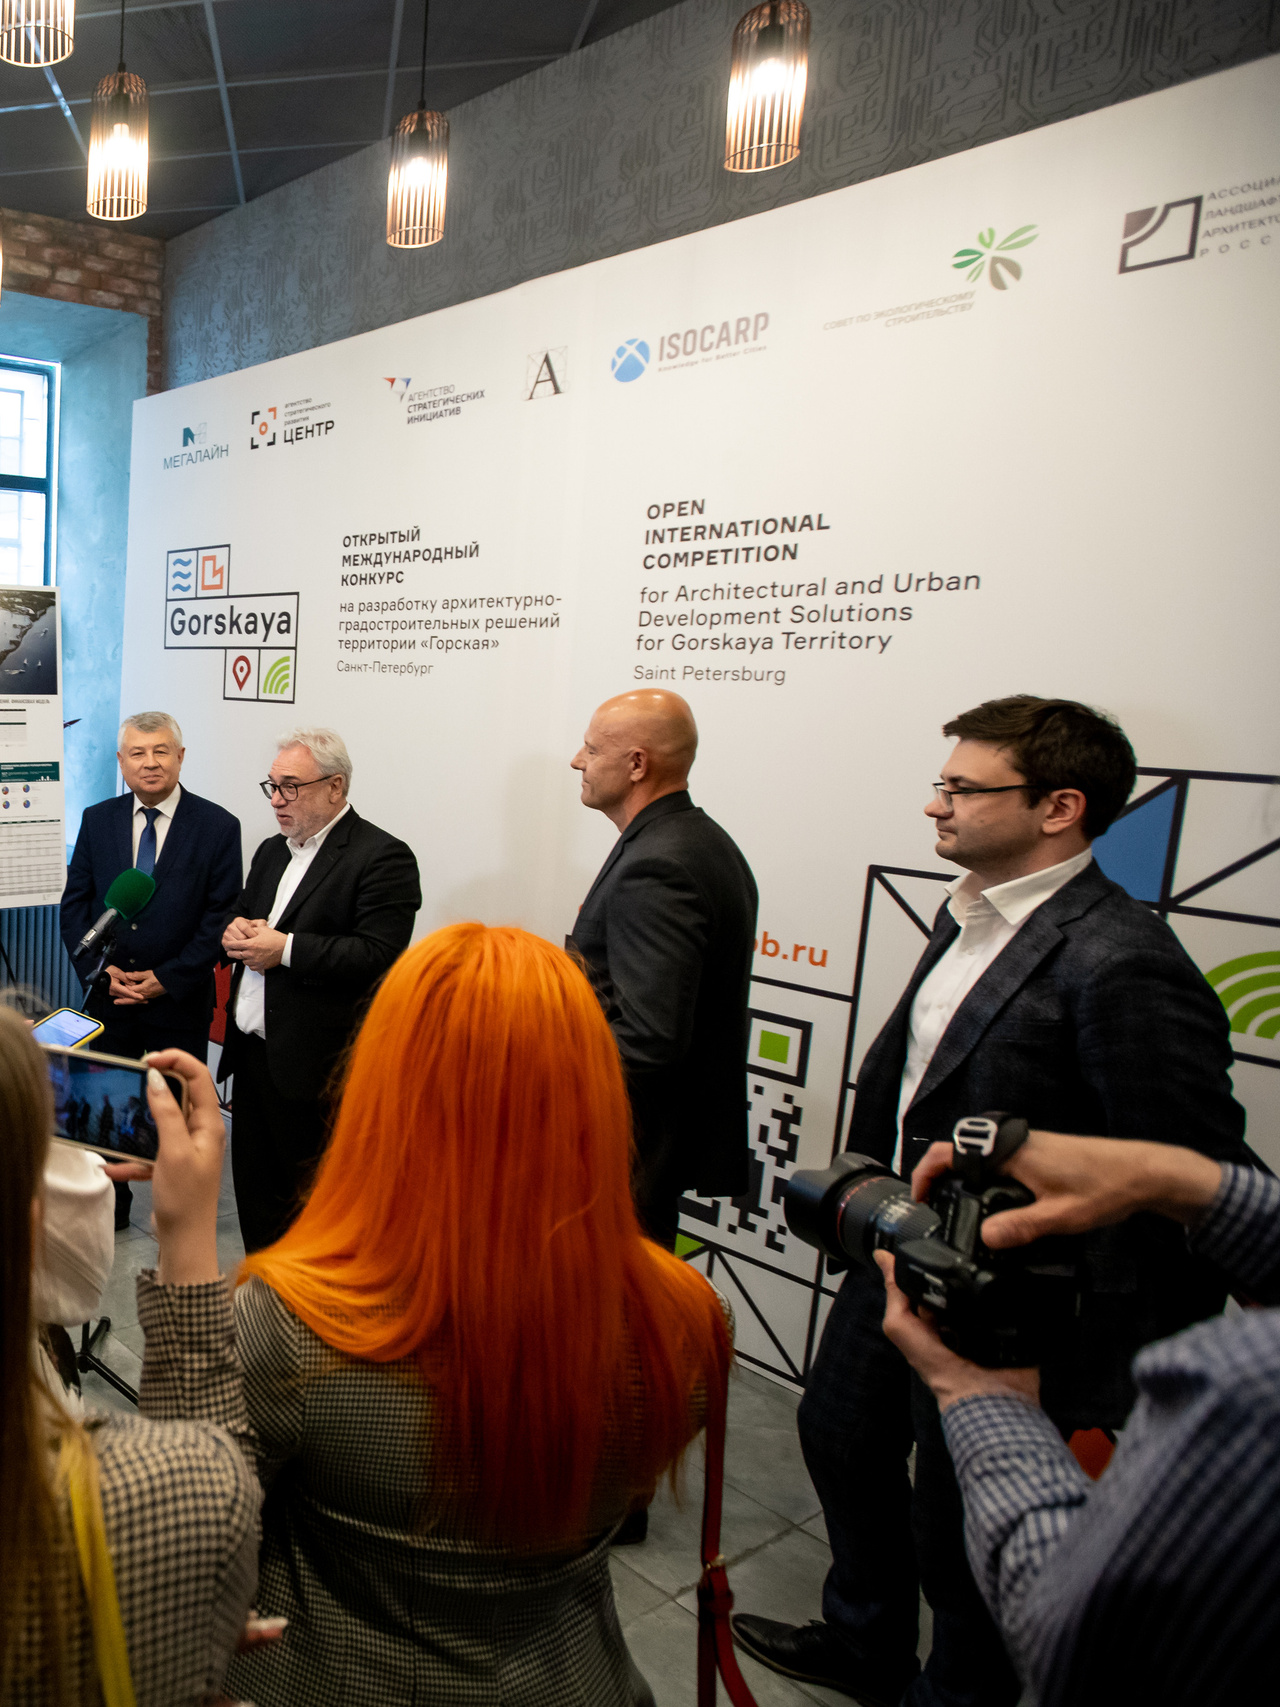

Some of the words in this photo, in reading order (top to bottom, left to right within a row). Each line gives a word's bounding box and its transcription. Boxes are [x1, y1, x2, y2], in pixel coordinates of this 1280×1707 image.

[1204, 194, 1280, 220] ЛАНДШАФ
[658, 312, 770, 362] ISOCARP
[407, 384, 455, 402] АГЕНТСТВО
[407, 389, 485, 414] СТРАТЕГИЧЕСКИХ
[407, 406, 461, 425] ИНИЦИАТИВ
[283, 420, 334, 446] ЦЕНТР
[163, 444, 229, 470] МЕГАЛАЙН
[647, 498, 705, 520] OPEN
[343, 525, 421, 547] ОТКРЫТЫЙ
[645, 513, 830, 545] INTERNATIONAL
[342, 541, 480, 568] МЕЖДУНАРОДНЫЙ
[643, 543, 798, 570] COMPETITION
[341, 571, 404, 587] КОНКУРС
[640, 587, 669, 603] for
[675, 577, 827, 602] Architectural
[835, 574, 884, 595] and
[894, 572, 981, 593] Urban
[340, 602, 354, 613] на
[358, 597, 438, 615] разработку
[441, 594, 562, 612] архитектурно-
[638, 607, 782, 630] Development
[790, 602, 913, 624] Solutions
[170, 605, 291, 642] Gorskaya
[339, 618, 480, 633] градостроительных
[485, 612, 560, 632] решений
[338, 637, 416, 653] территории
[420, 635, 499, 653] «Горская»
[636, 634, 665, 651] for
[672, 633, 773, 654] Gorskaya
[781, 631, 893, 654] Territory
[337, 660, 434, 677] Санкт-Петербург
[634, 665, 676, 680] Saint
[682, 665, 786, 686] Petersburg
